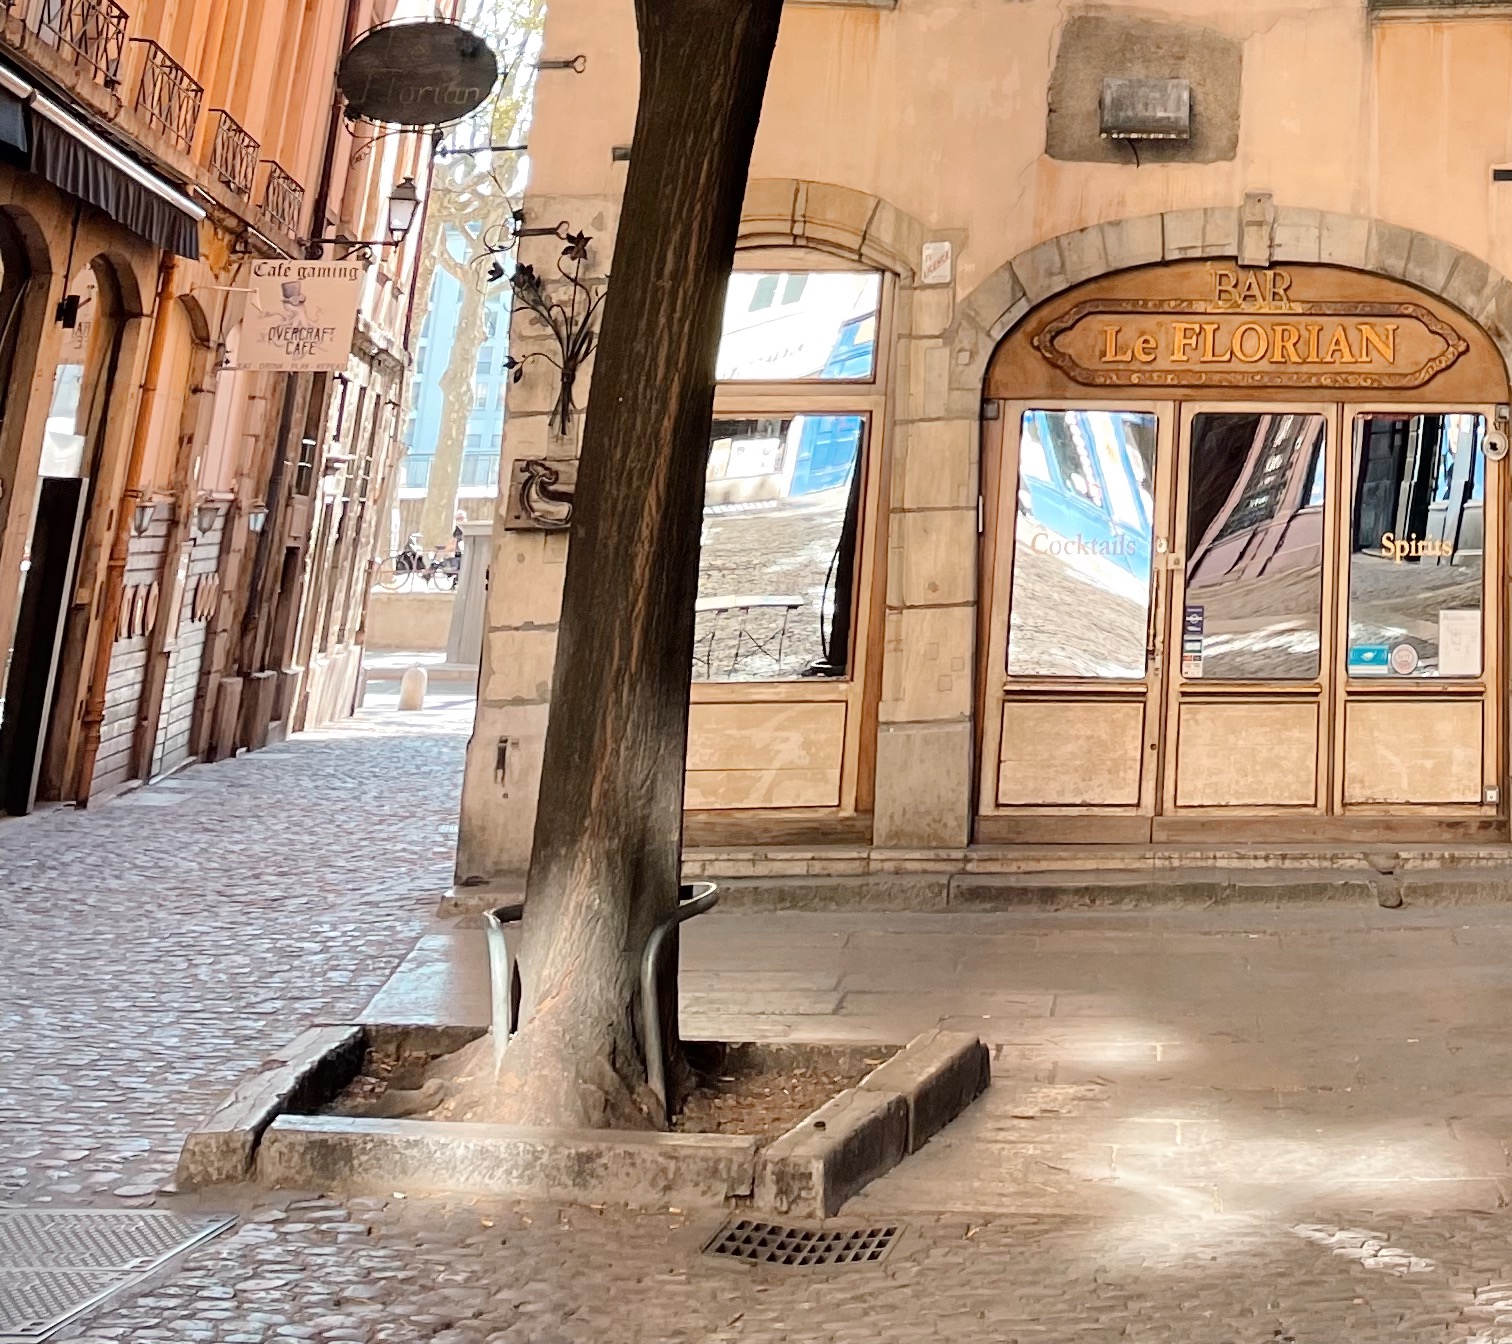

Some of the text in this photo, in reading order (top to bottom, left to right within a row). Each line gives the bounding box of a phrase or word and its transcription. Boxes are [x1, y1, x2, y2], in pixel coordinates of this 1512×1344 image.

[297, 266, 360, 281] gaming
[1208, 268, 1294, 310] BAR
[268, 326, 337, 342] OVERCRAFT
[1101, 321, 1400, 364] Le FLORIAN
[285, 341, 318, 356] CAFE
[1030, 531, 1137, 556] Cocktails
[1381, 531, 1453, 564] Spirits
